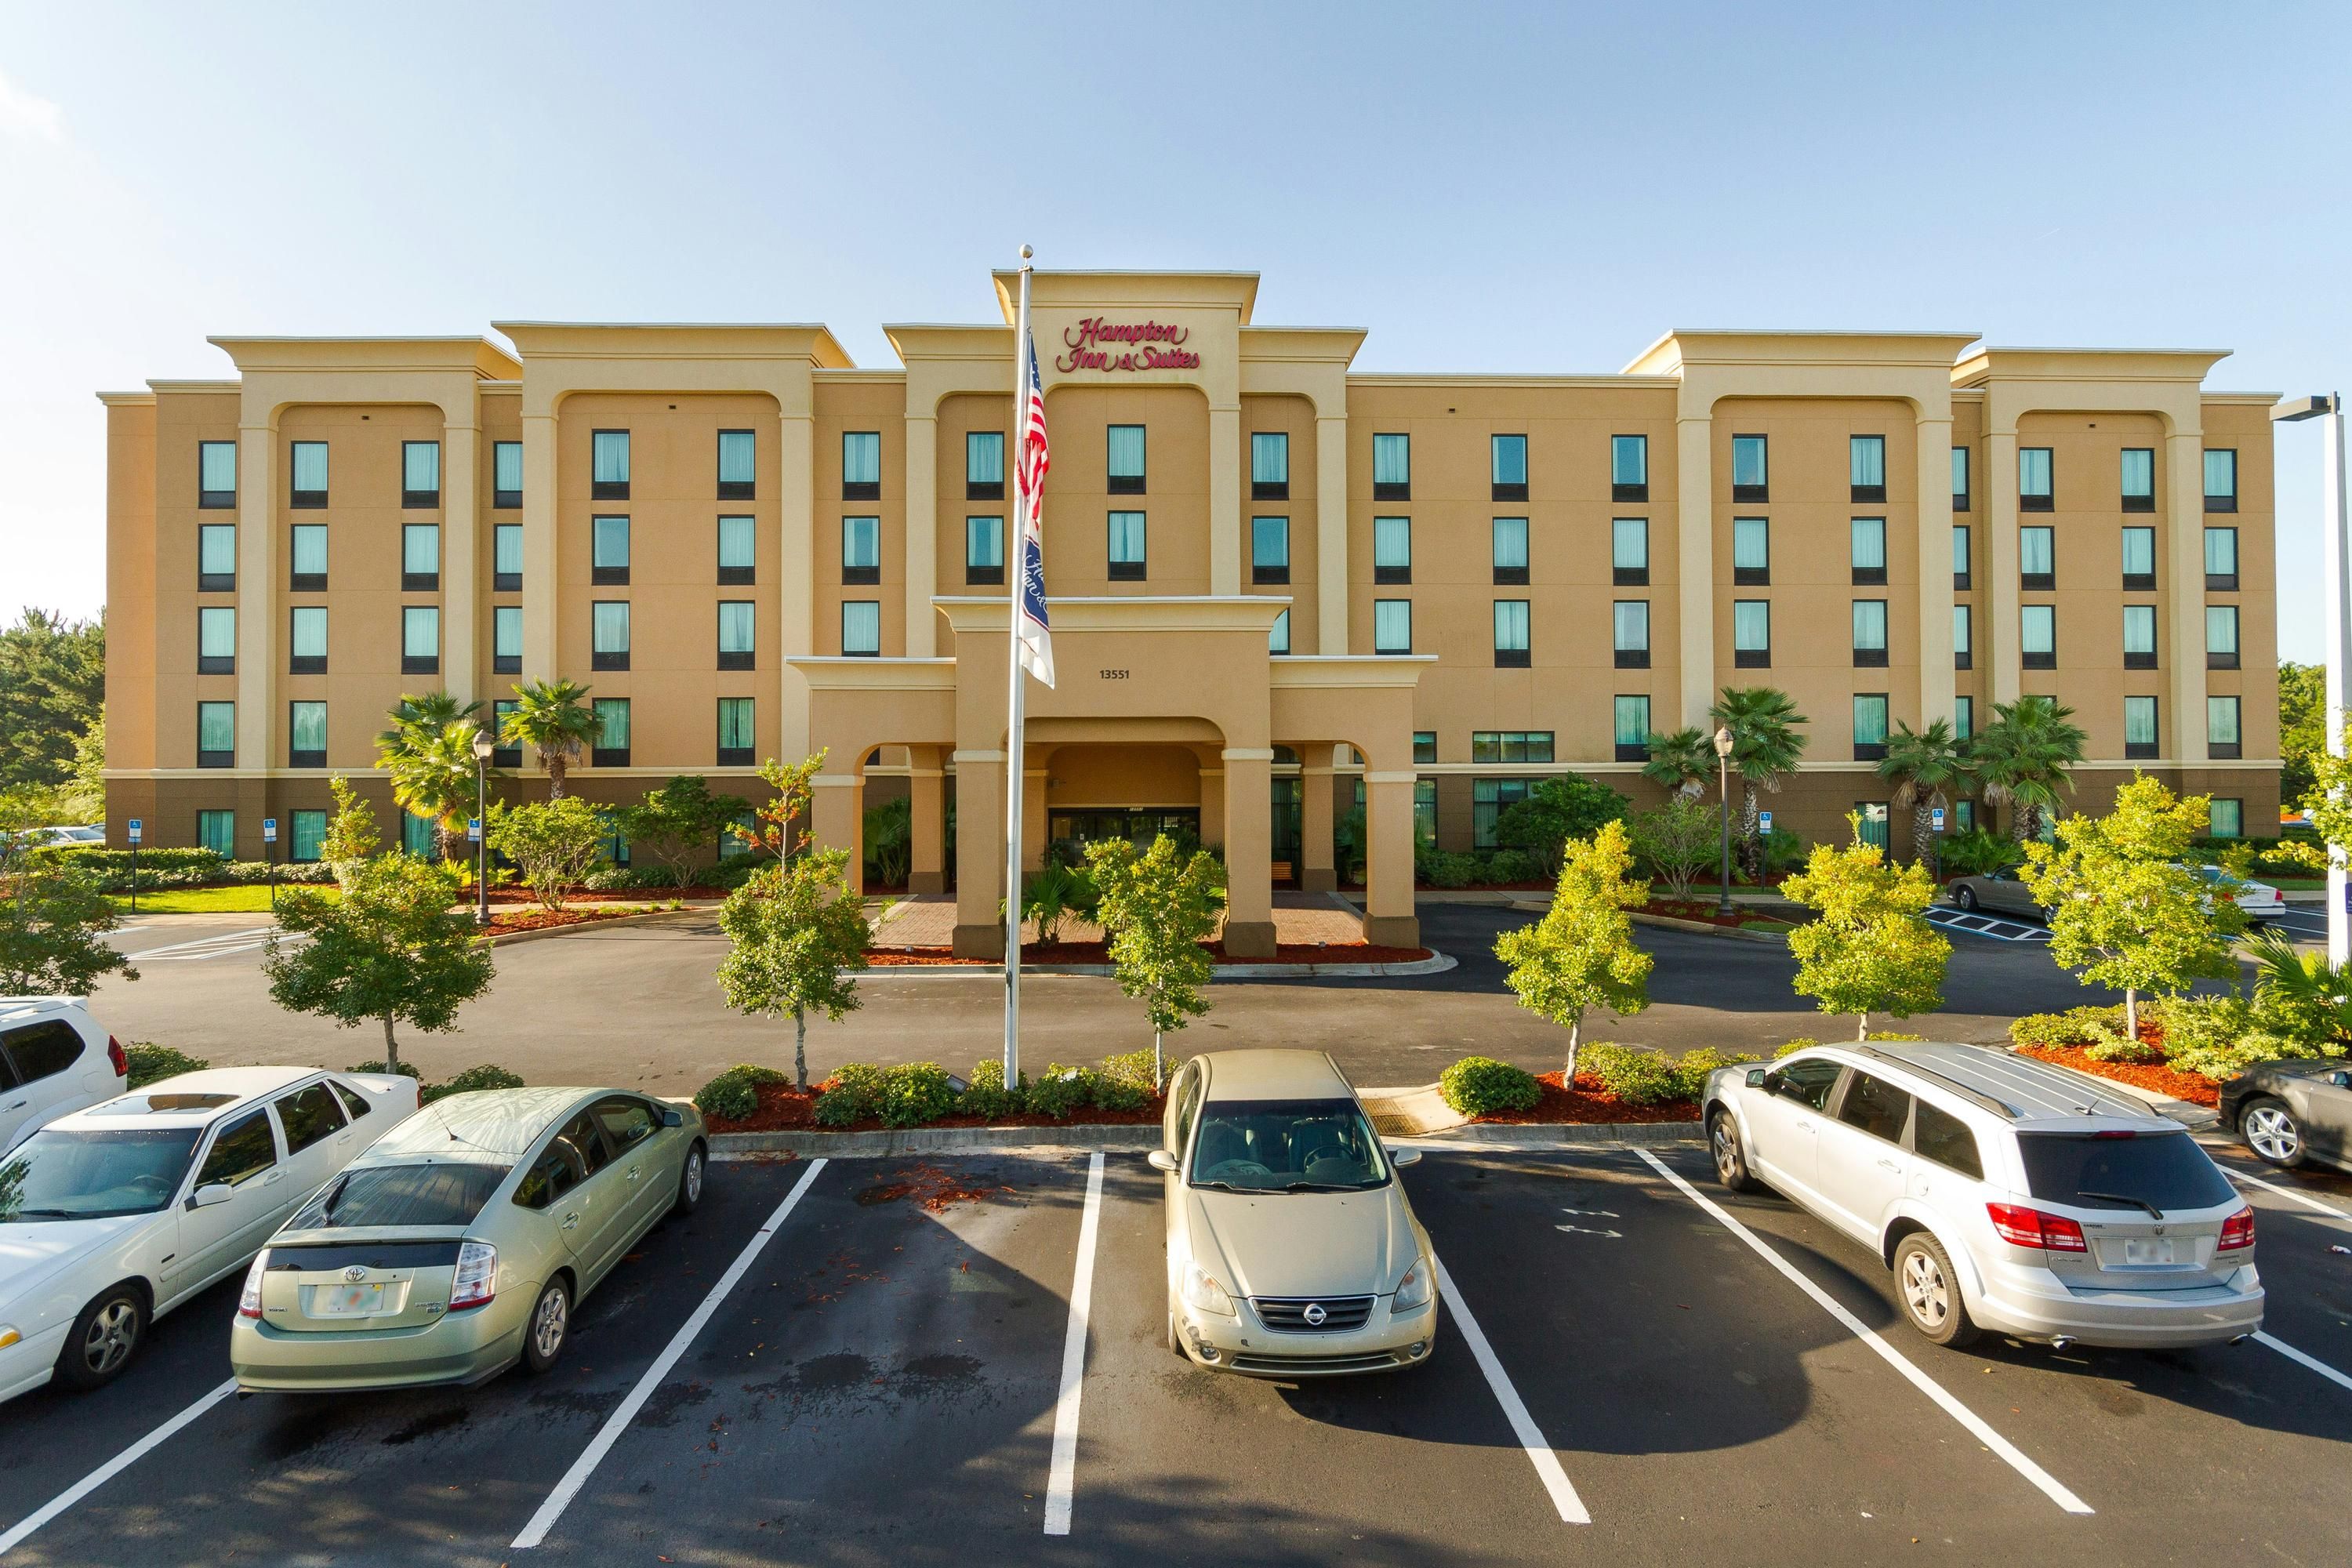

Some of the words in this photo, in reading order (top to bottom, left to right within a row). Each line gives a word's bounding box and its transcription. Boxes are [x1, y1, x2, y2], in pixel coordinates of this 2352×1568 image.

[1064, 316, 1189, 348] Hampton
[1055, 347, 1119, 373] Inn
[1119, 353, 1136, 372] &
[1134, 346, 1200, 370] Suites
[1099, 670, 1129, 679] 13551
